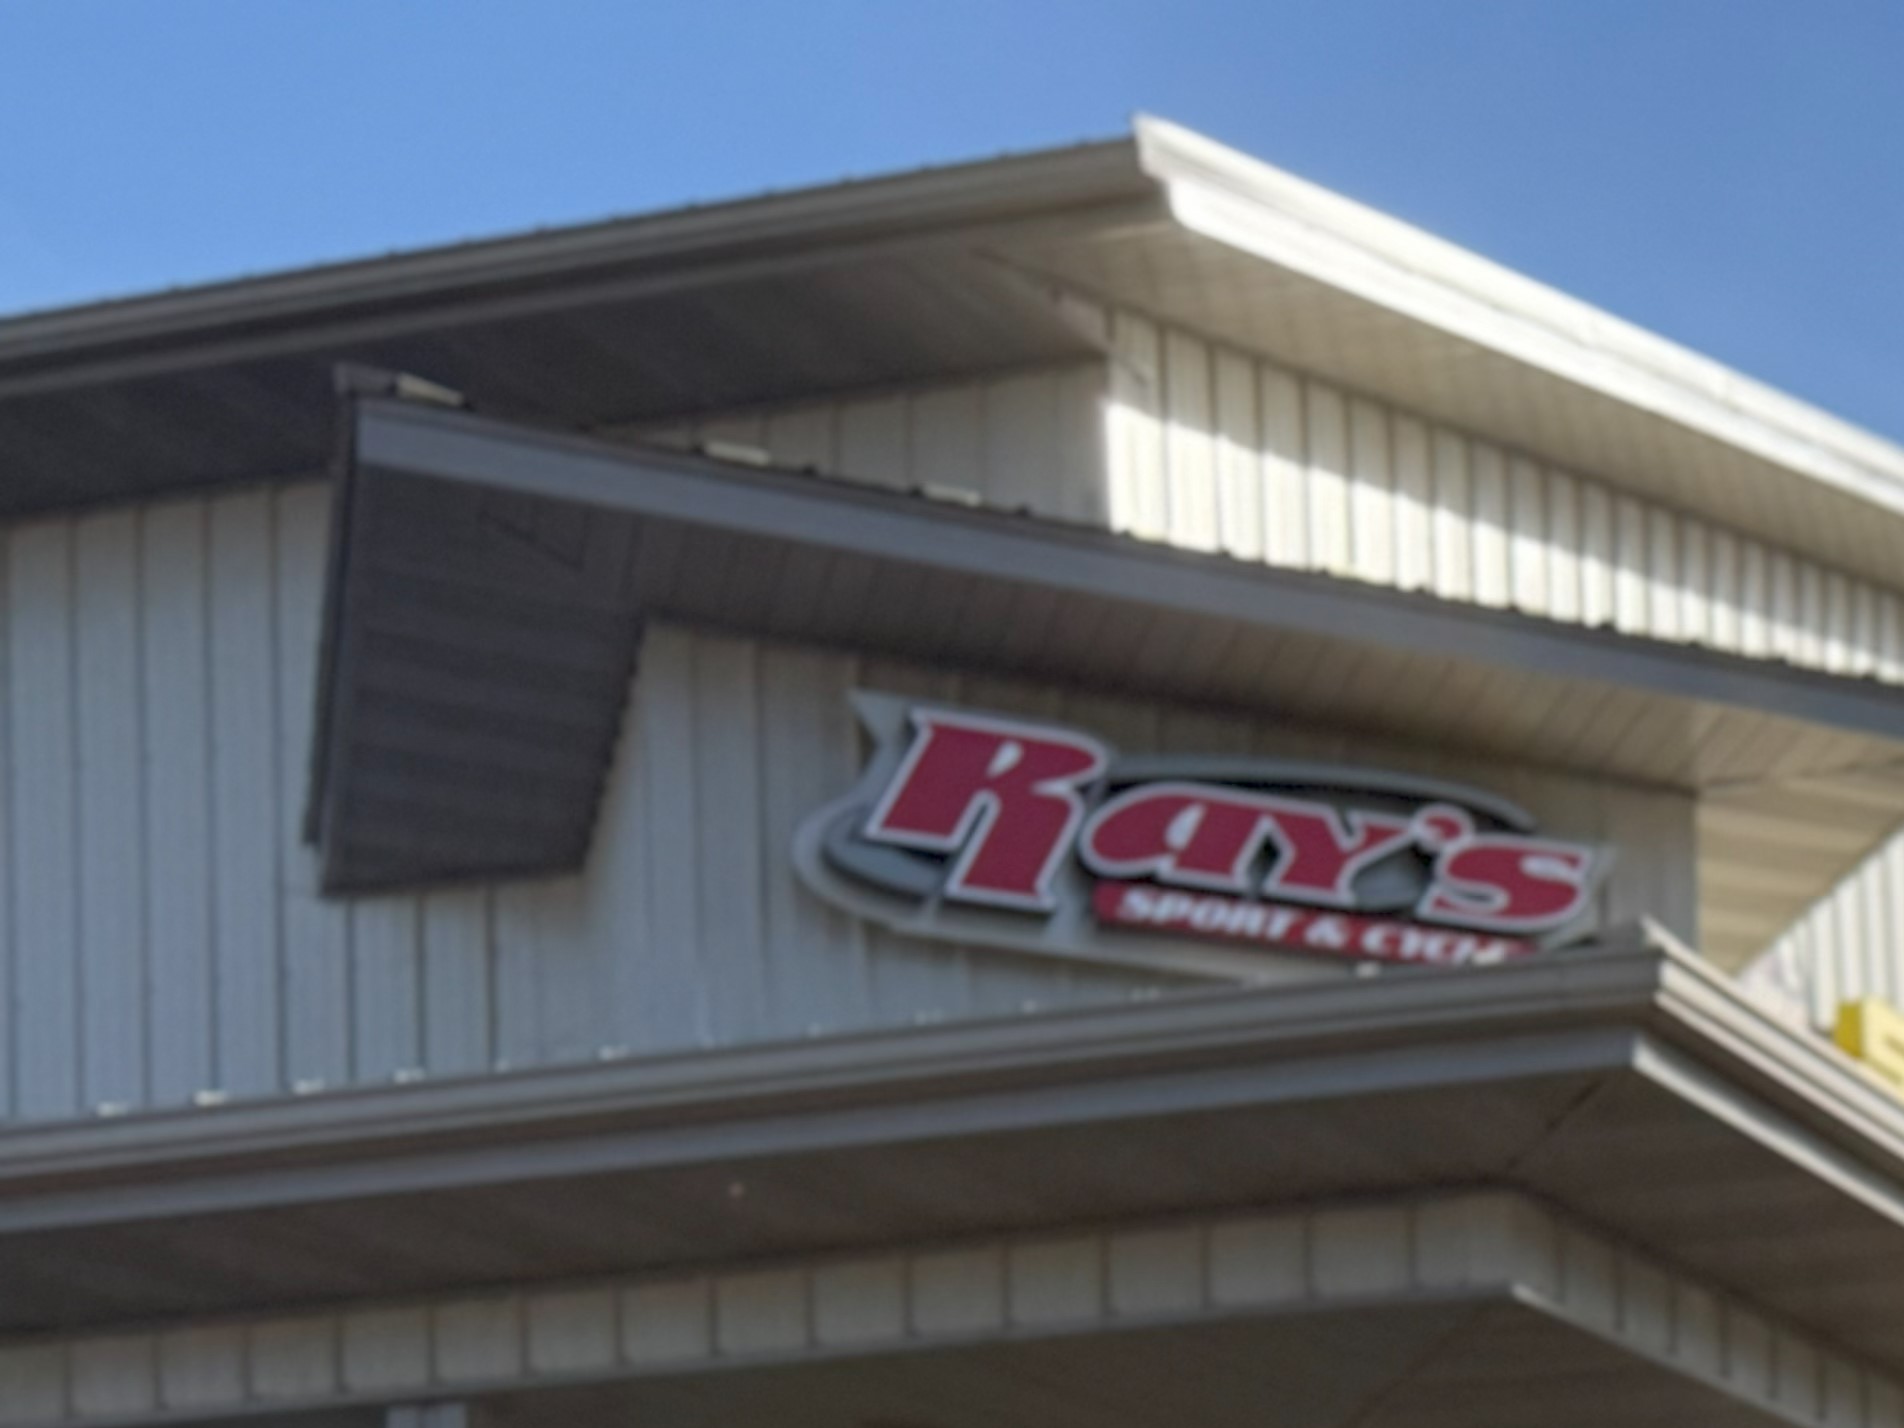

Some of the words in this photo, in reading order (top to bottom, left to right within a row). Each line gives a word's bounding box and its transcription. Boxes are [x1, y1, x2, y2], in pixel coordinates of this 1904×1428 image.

[866, 710, 1595, 930] Ray's
[1116, 888, 1297, 941] SPORT
[1304, 914, 1349, 950] &
